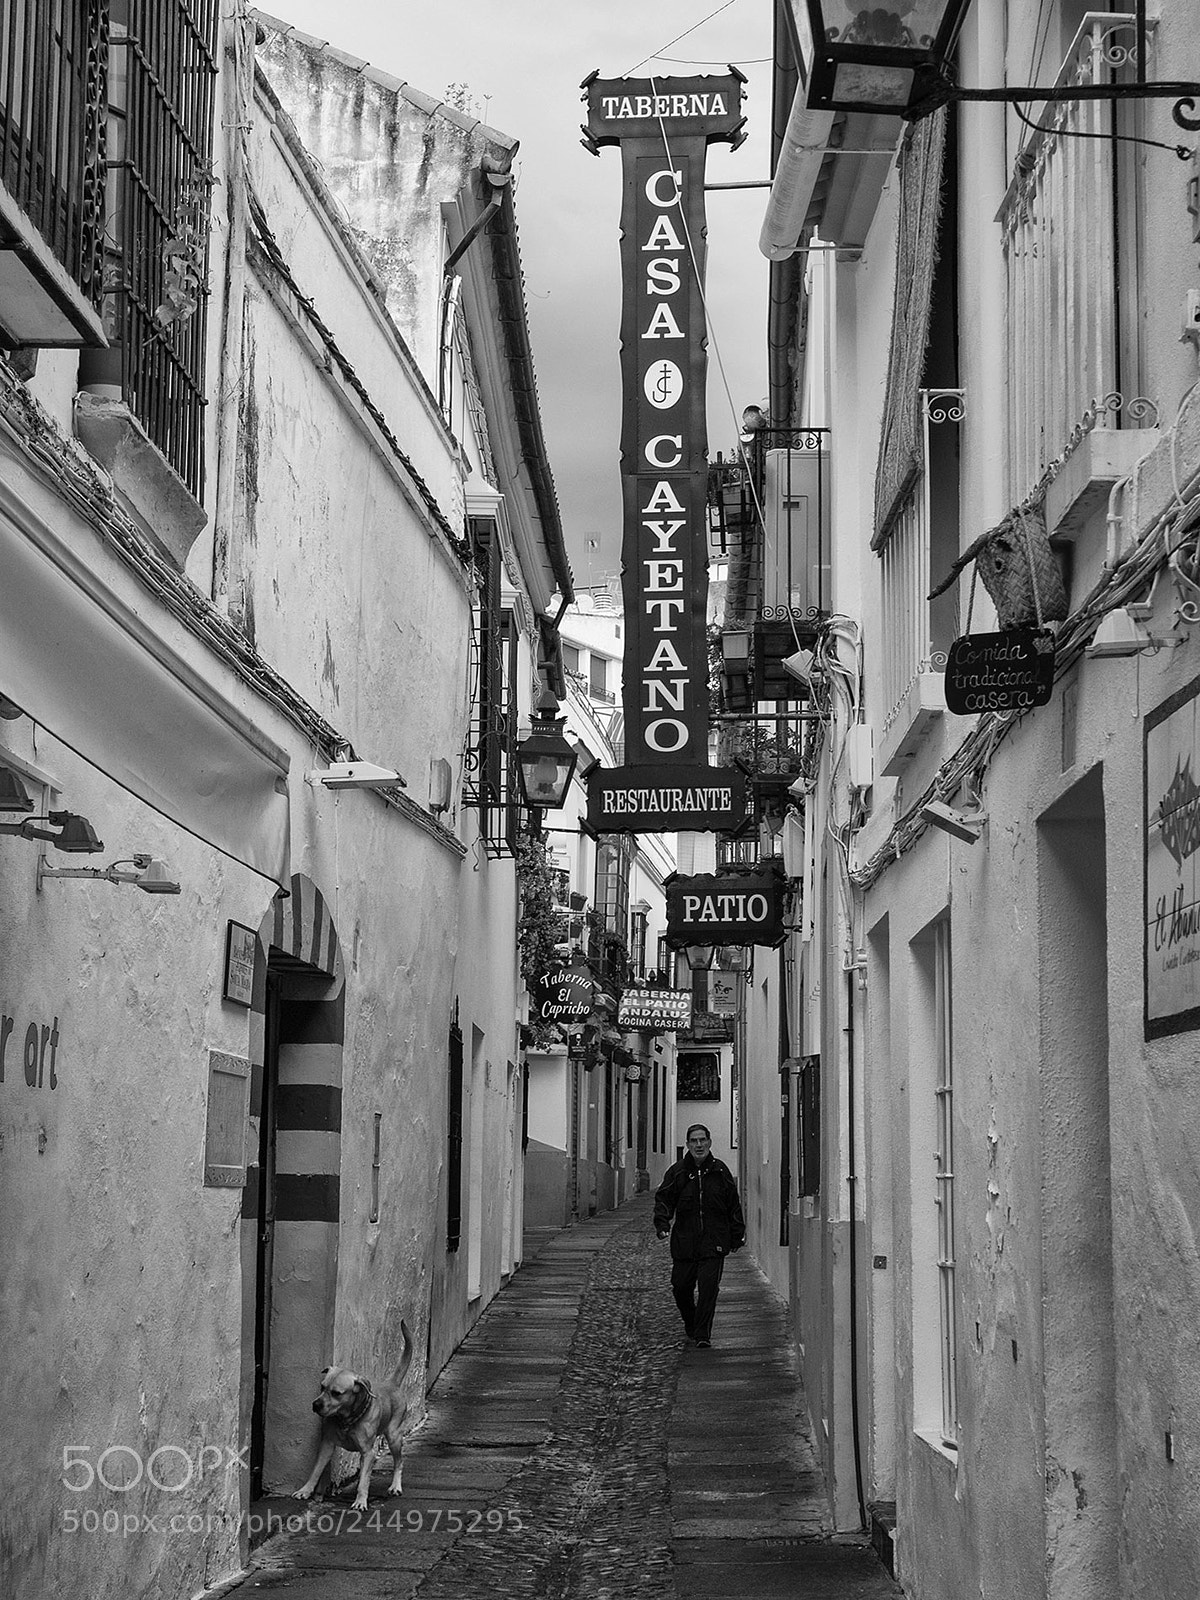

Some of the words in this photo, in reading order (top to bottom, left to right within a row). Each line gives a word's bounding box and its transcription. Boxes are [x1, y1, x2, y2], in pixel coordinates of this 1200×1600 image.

[602, 93, 728, 119] TABERNA
[641, 168, 685, 341] CASA
[641, 433, 691, 755] CAYETANO
[955, 636, 1028, 665] Comida
[601, 786, 733, 814] RESTAURANTE
[682, 893, 769, 923] PATIO
[540, 969, 593, 989] Taberna
[557, 988, 572, 1002] El
[621, 988, 691, 1000] TABERNA
[623, 998, 640, 1006] EL
[645, 999, 688, 1009] PATIO
[541, 1000, 591, 1019] Capricho
[619, 1007, 691, 1019] ANDALUZ
[618, 1017, 652, 1026] COCINA
[654, 1019, 691, 1029] CASERA
[24, 1016, 60, 1091] art
